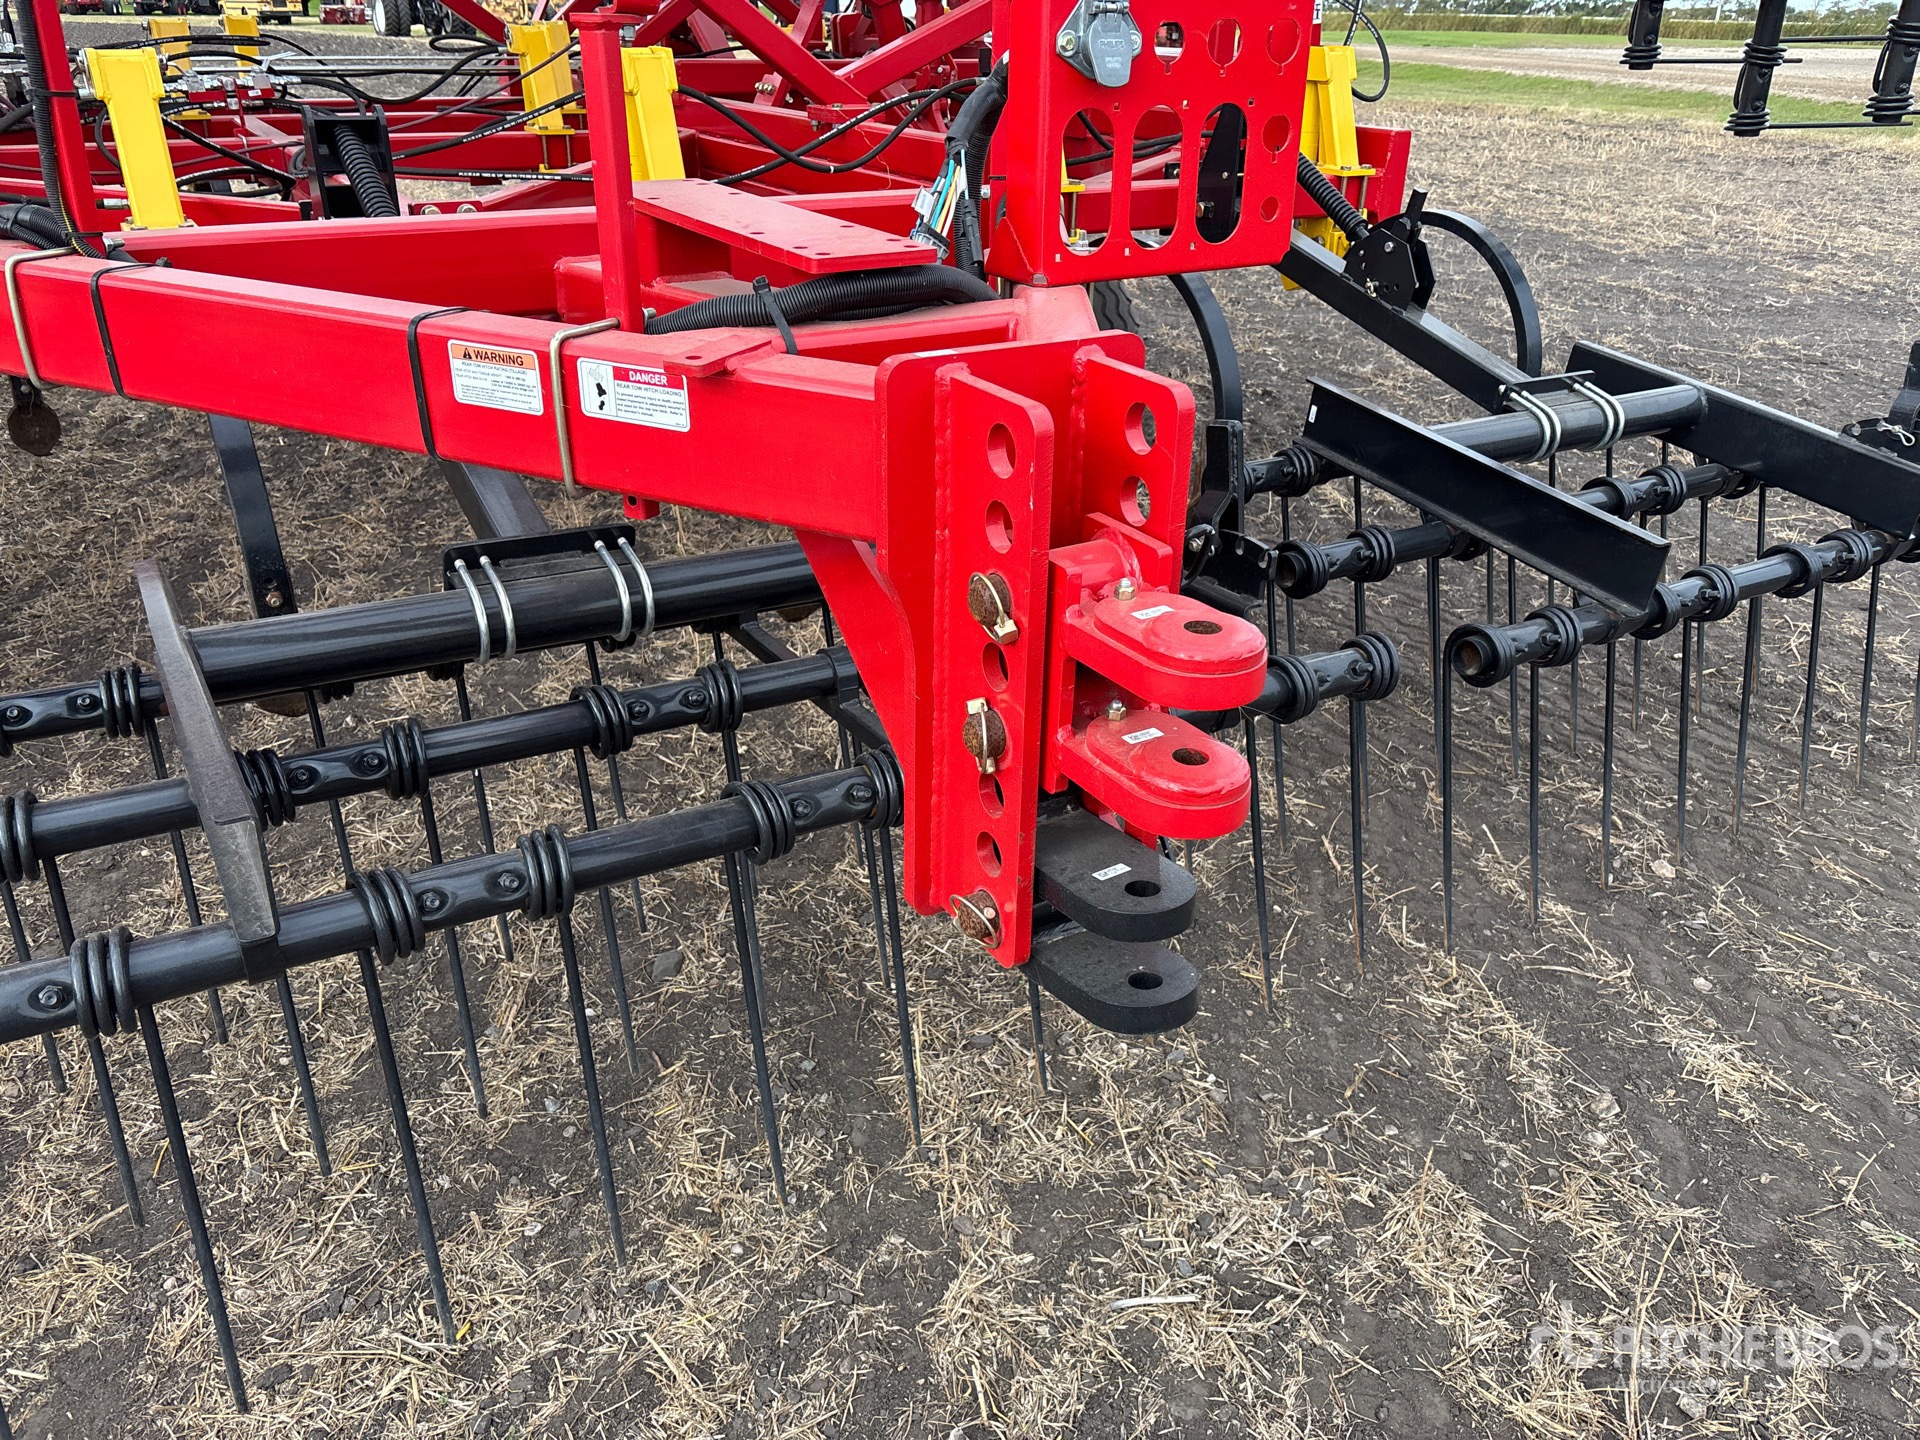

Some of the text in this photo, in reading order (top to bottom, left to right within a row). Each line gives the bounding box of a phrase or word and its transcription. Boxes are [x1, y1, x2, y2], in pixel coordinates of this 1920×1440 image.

[473, 349, 524, 366] WARNING
[628, 370, 668, 386] DANGER
[660, 388, 682, 397] LOADING
